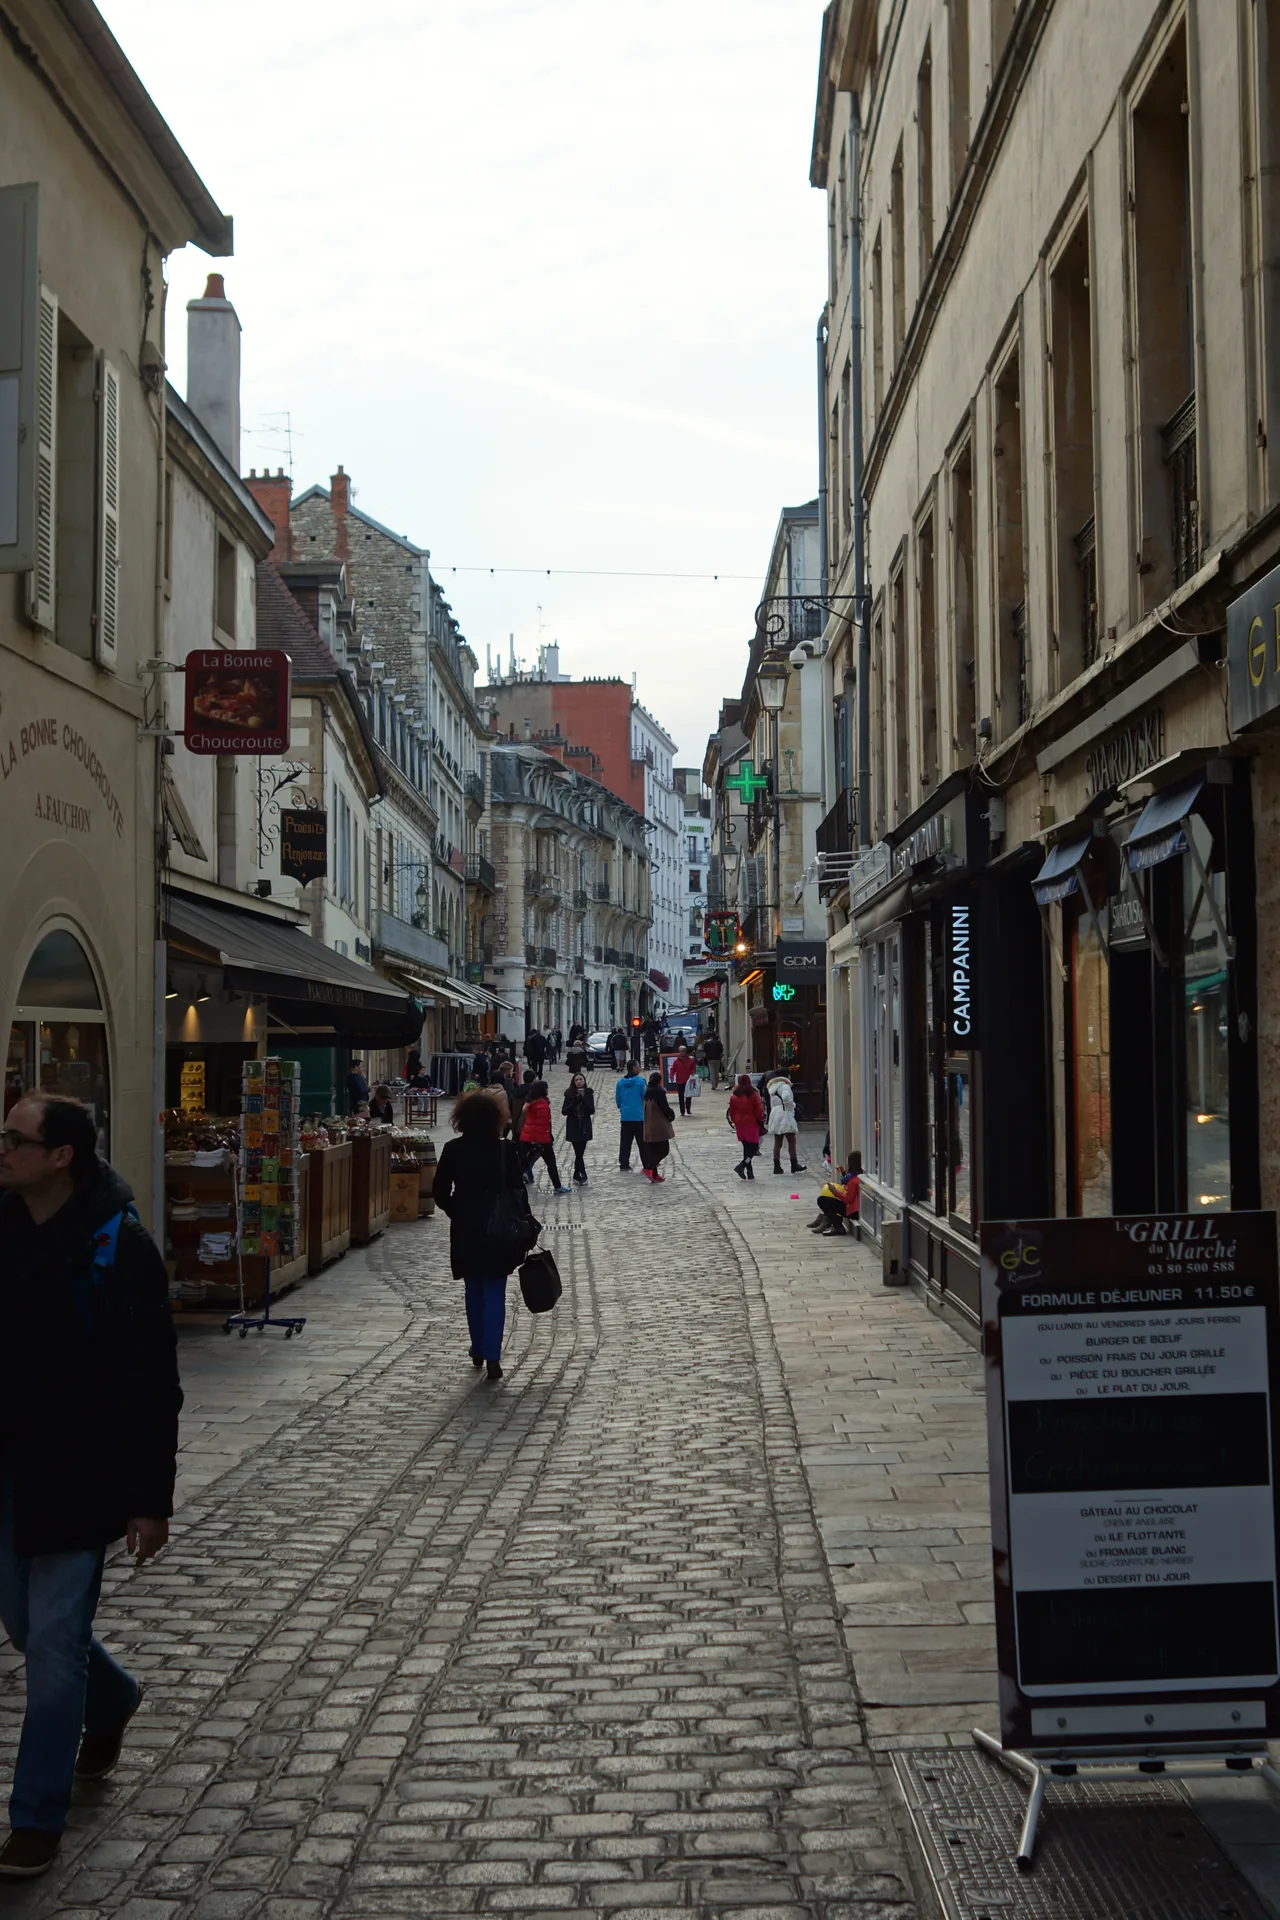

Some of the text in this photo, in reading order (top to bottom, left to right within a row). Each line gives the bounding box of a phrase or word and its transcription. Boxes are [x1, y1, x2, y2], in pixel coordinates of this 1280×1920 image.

[1247, 602, 1280, 688] G
[202, 653, 273, 668] La Bonne
[189, 734, 283, 749] Choucroute
[1086, 707, 1163, 797] SWAROVSKI
[1, 718, 124, 839] LA BONNE CHOUCROUTE
[783, 956, 817, 966] GDM
[952, 905, 971, 1036] CAMPANINI
[1115, 1219, 1220, 1242] Le GRILL
[1148, 1238, 1237, 1260] du Marché
[1148, 1260, 1236, 1275] 03 80 500 588
[1020, 1291, 1096, 1307] FORMULE
[1100, 1287, 1183, 1304] DÉJEUNER
[1055, 1322, 1083, 1331] LUNDI
[1086, 1321, 1099, 1329] AU
[1101, 1319, 1147, 1329] VENDREDI
[1148, 1318, 1173, 1327] SAUF
[1175, 1317, 1206, 1326] JOURS
[1085, 1336, 1130, 1346] BURGER
[1132, 1335, 1147, 1345] DE
[1057, 1355, 1103, 1365] POISSON
[1106, 1353, 1137, 1363] FRAIS
[1140, 1351, 1155, 1361] DU
[1158, 1350, 1188, 1360] JOUR
[1102, 1369, 1118, 1379] DU
[1121, 1367, 1172, 1378] BOUCHER
[1097, 1385, 1110, 1395] LE
[1112, 1384, 1139, 1393] PLAT
[1141, 1383, 1157, 1392] DU
[1126, 1506, 1140, 1515] AU
[1143, 1504, 1198, 1515] CHOCOLAT
[1109, 1532, 1124, 1541] ILE
[1127, 1530, 1186, 1540] FLOTTANTE
[1099, 1547, 1149, 1557] FROMAGE
[1151, 1545, 1187, 1555] BLANC
[1097, 1574, 1142, 1584] DESSERT
[1145, 1573, 1160, 1582] DU
[1163, 1572, 1191, 1581] JOUR
